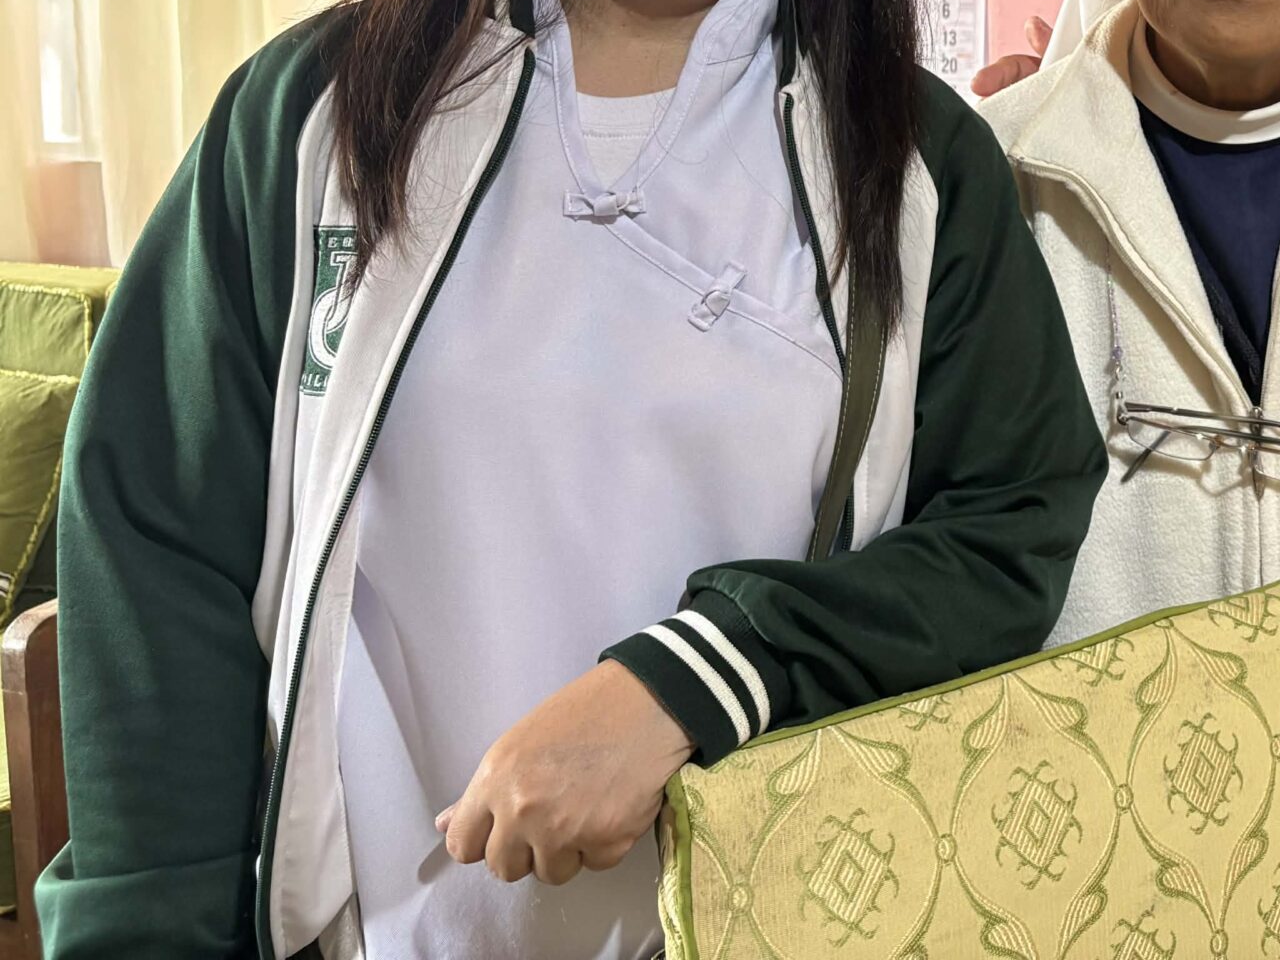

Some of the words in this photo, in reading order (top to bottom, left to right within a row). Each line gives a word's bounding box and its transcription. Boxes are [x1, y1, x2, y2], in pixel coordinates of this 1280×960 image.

[941, 3, 950, 19] 6
[942, 30, 957, 47] 13
[941, 58, 958, 74] 20
